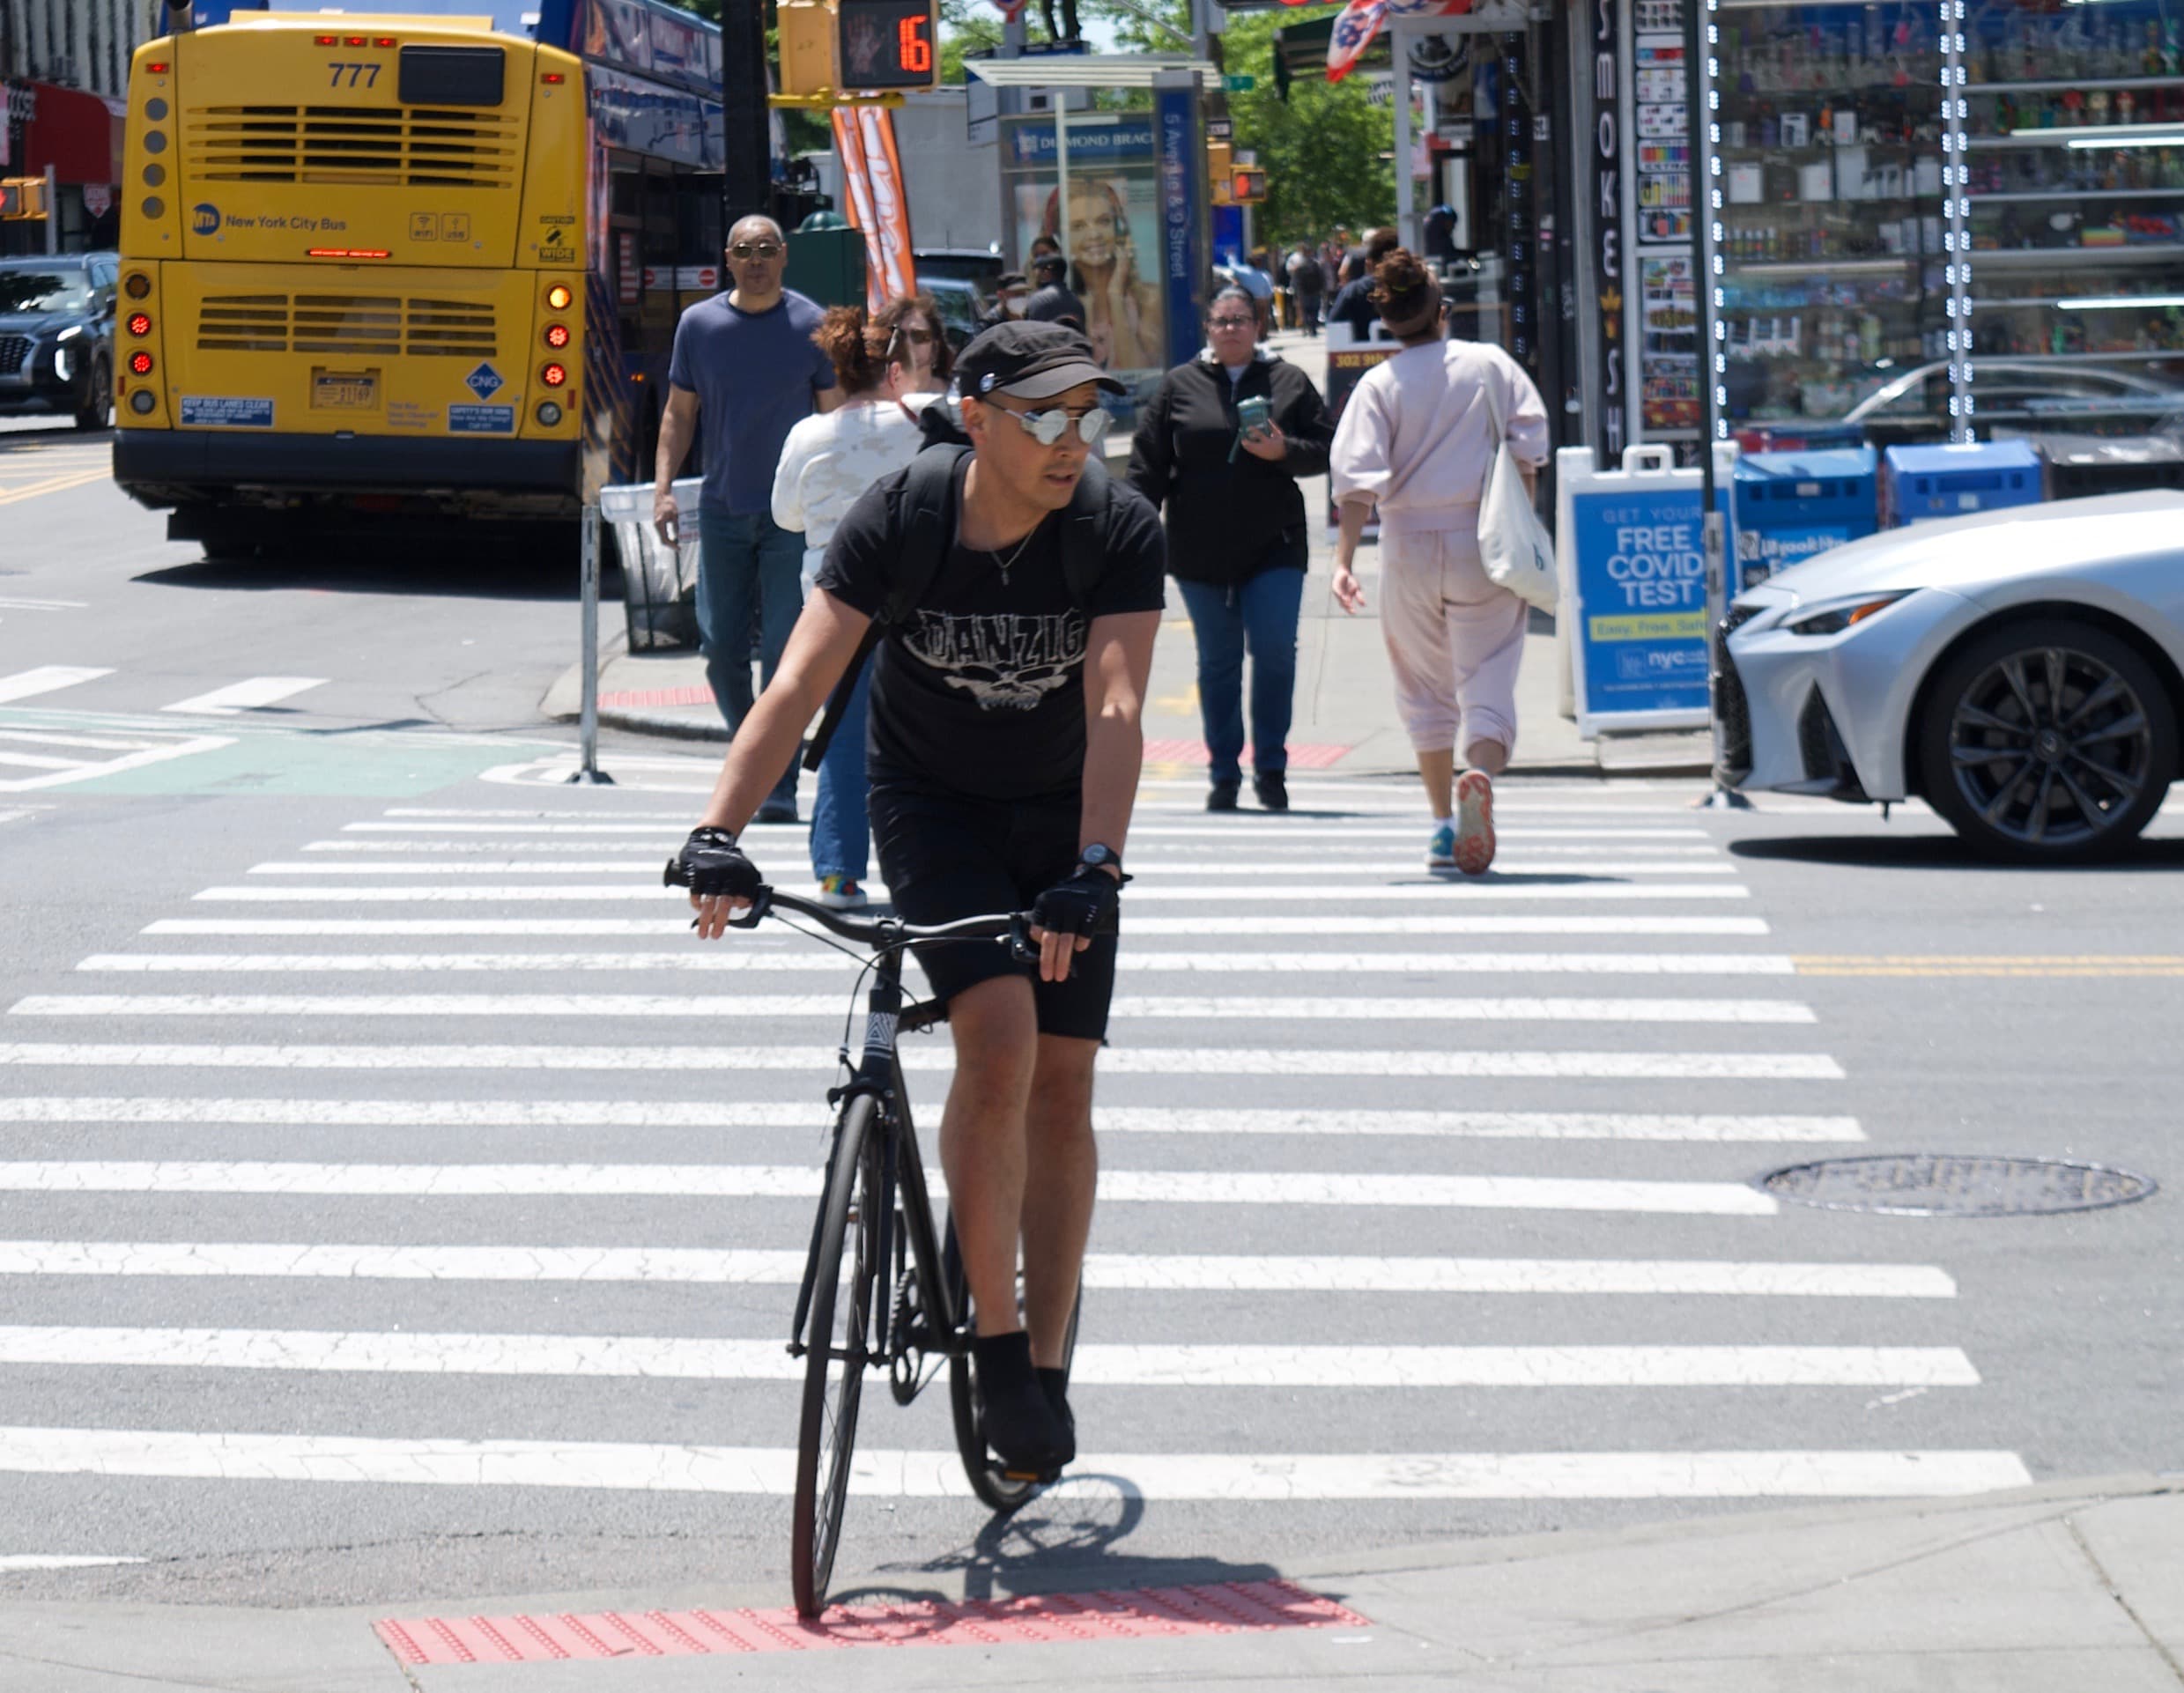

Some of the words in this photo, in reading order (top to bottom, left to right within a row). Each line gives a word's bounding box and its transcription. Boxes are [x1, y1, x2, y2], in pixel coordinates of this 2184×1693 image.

[900, 14, 930, 72] 16
[329, 63, 381, 87] 777
[1164, 114, 1181, 124] 5
[1165, 127, 1181, 190] Avenue
[1167, 195, 1183, 207] &
[226, 216, 255, 227] New
[258, 216, 286, 228] York
[290, 217, 316, 231] City
[321, 218, 346, 231] Bus
[1168, 211, 1182, 223] 9
[1169, 227, 1187, 278] Street
[470, 375, 499, 388] CNG
[203, 399, 218, 408] BUS
[219, 400, 244, 409] LANES
[246, 400, 270, 410] CLEAR
[1603, 507, 1640, 523] GET
[1649, 506, 1702, 521] YOUR
[1617, 525, 1692, 552] FREE
[1607, 552, 1704, 580] COVID
[1618, 579, 1695, 606] TEST
[1596, 622, 1632, 636] Easy.
[1638, 620, 1671, 632] Free.
[907, 607, 1085, 669] DANZIG
[1648, 651, 1685, 669] nyc
